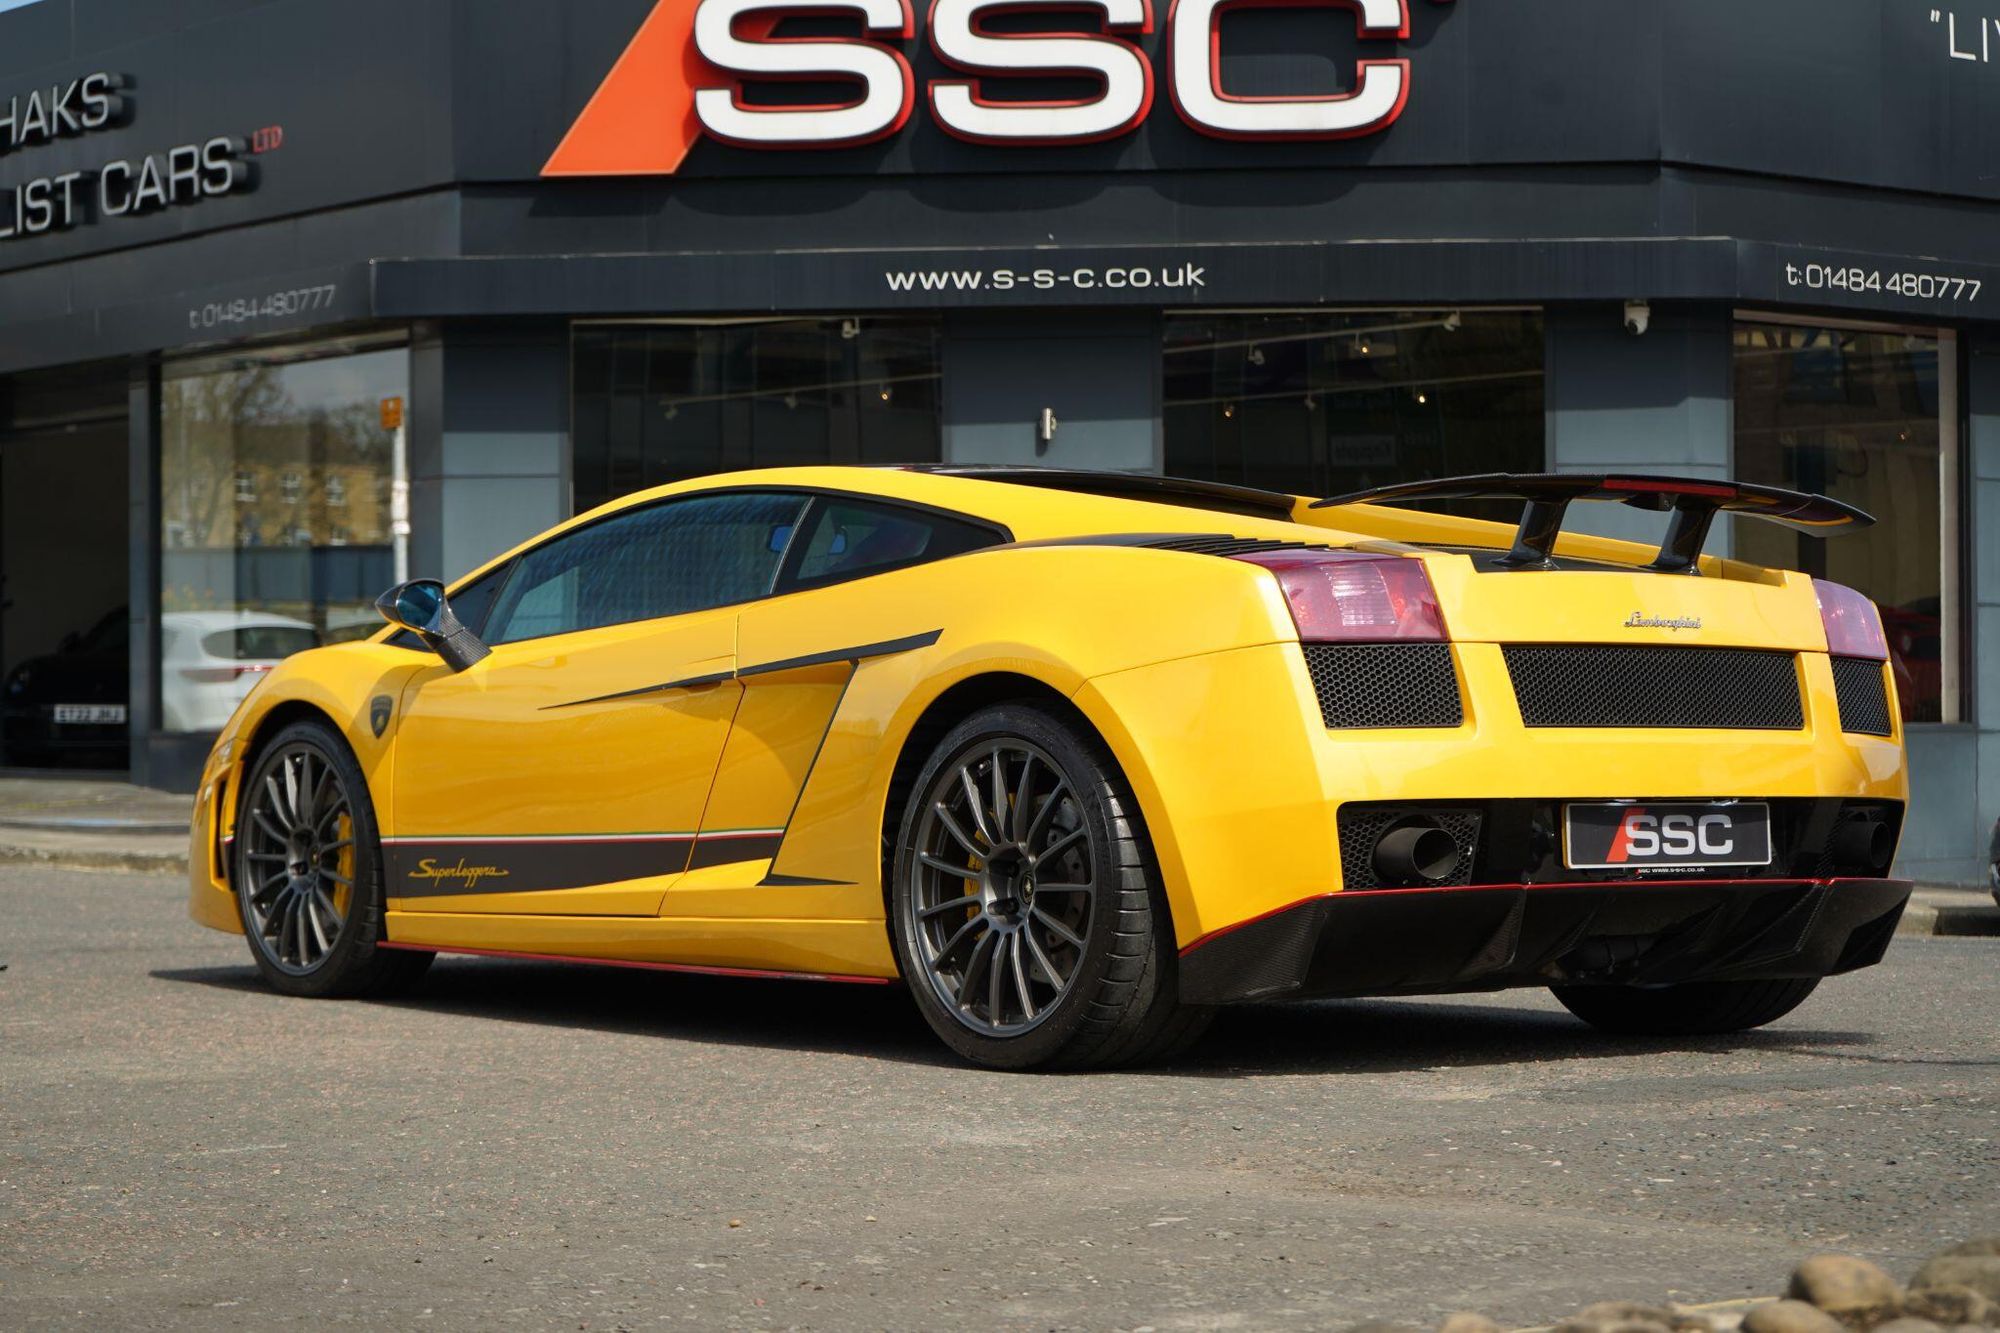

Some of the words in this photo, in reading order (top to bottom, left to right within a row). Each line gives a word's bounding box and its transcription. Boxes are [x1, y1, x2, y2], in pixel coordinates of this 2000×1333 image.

[1930, 9, 2000, 63] "LI
[694, 0, 1408, 147] SSC
[100, 136, 233, 216] CARS
[253, 126, 283, 153] LTD
[885, 262, 1206, 291] www.s-s-c.co.uk
[1624, 611, 1702, 632] Lamborghini
[1625, 814, 1733, 856] SSC
[408, 857, 510, 888] Superleggera
